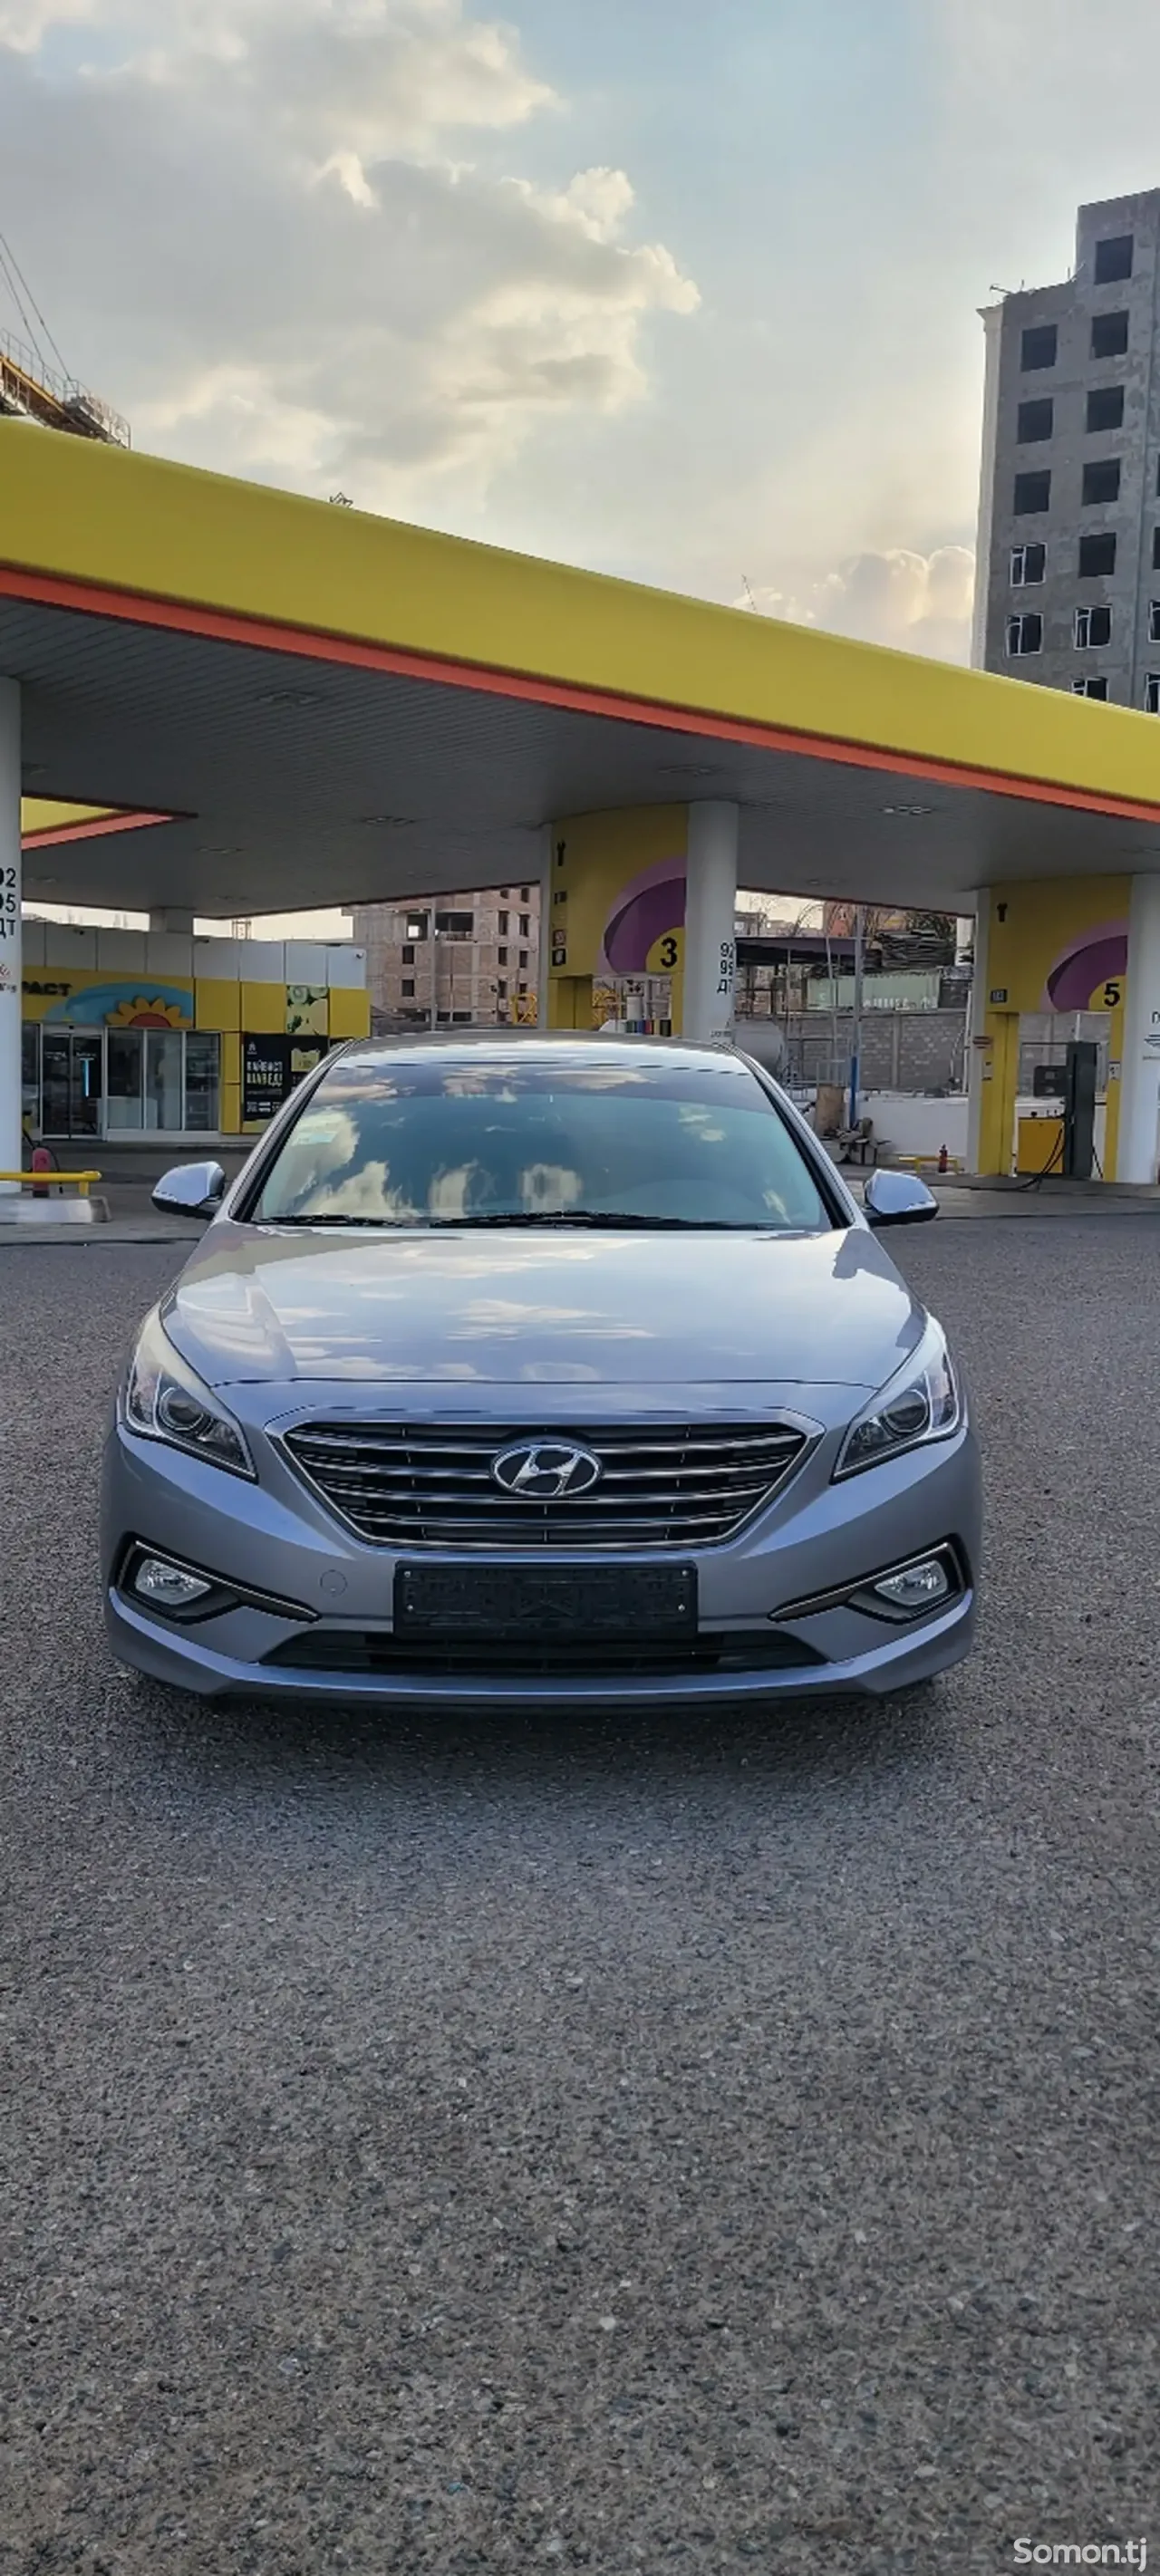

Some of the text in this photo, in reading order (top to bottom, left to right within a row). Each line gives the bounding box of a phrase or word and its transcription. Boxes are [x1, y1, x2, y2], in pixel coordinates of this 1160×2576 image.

[660, 937, 678, 968] 3
[720, 942, 734, 959] 92
[1103, 982, 1121, 1008] 5
